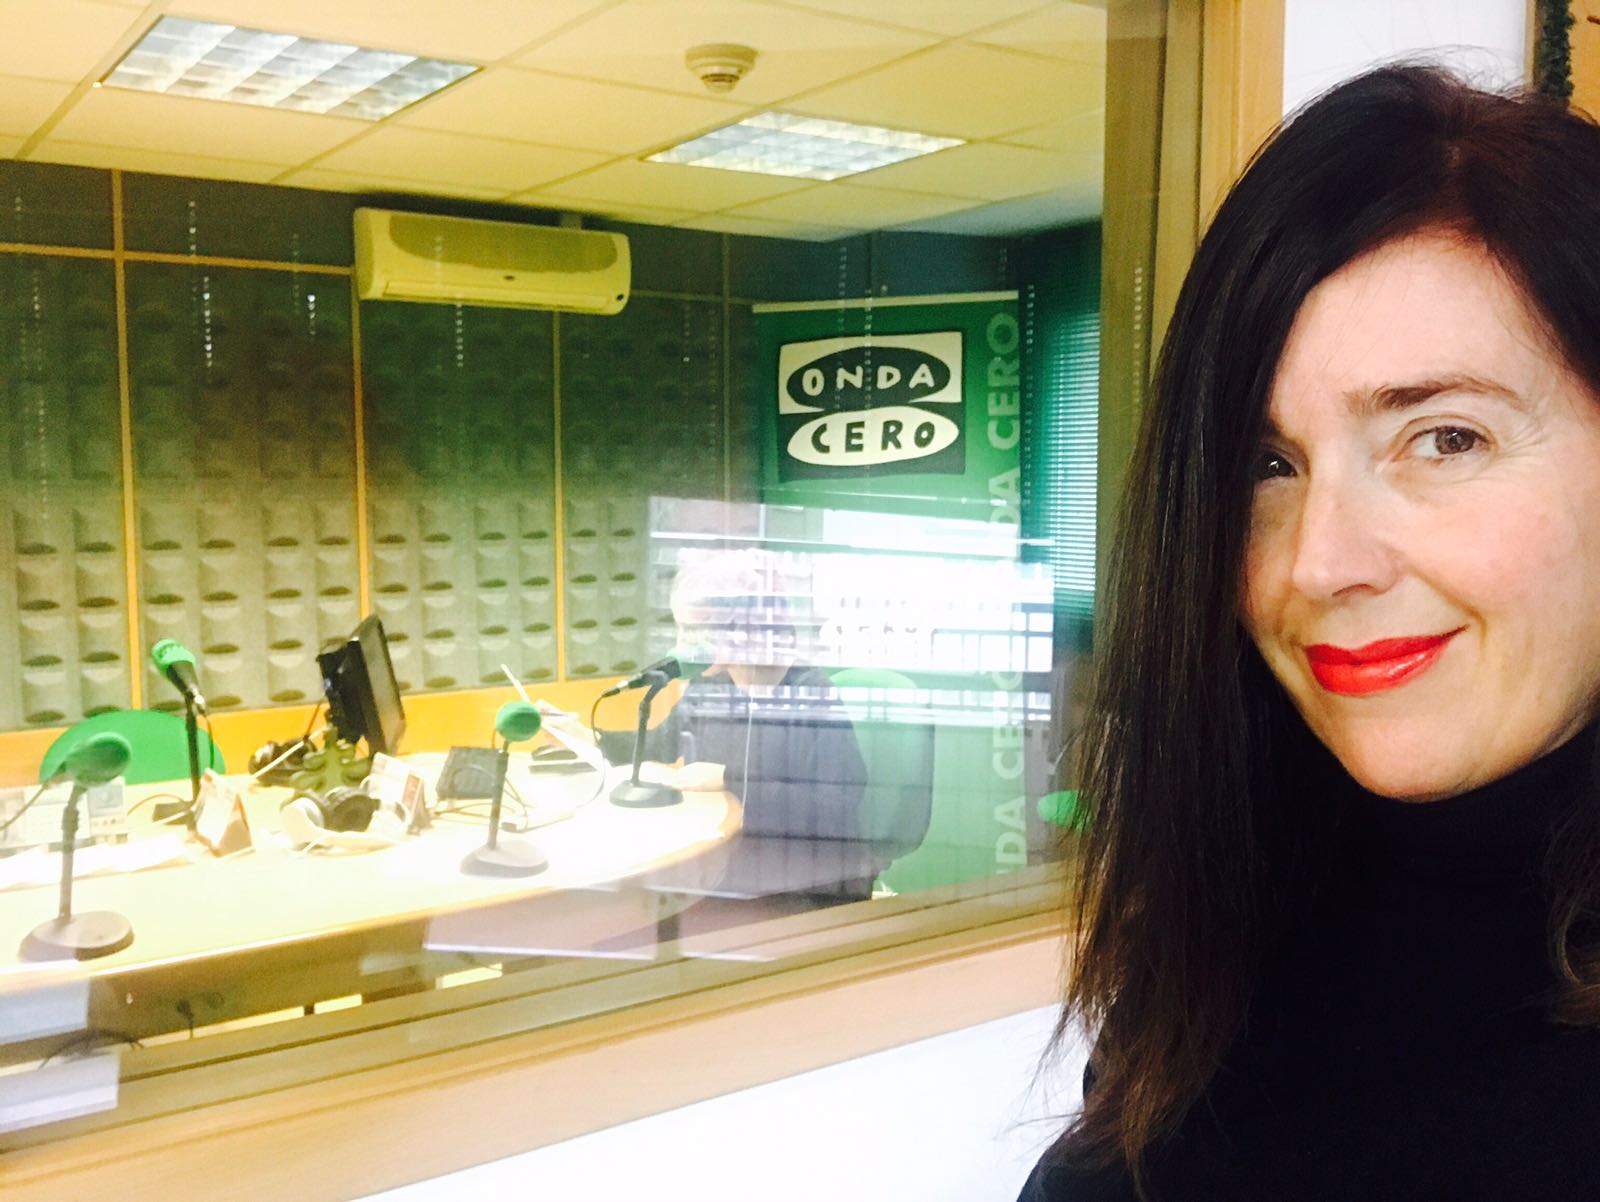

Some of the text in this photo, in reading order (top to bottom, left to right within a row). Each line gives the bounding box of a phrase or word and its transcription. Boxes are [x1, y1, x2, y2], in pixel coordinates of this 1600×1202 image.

[802, 363, 935, 396] ONDA
[986, 312, 1021, 450] CERO
[811, 419, 935, 454] CERO
